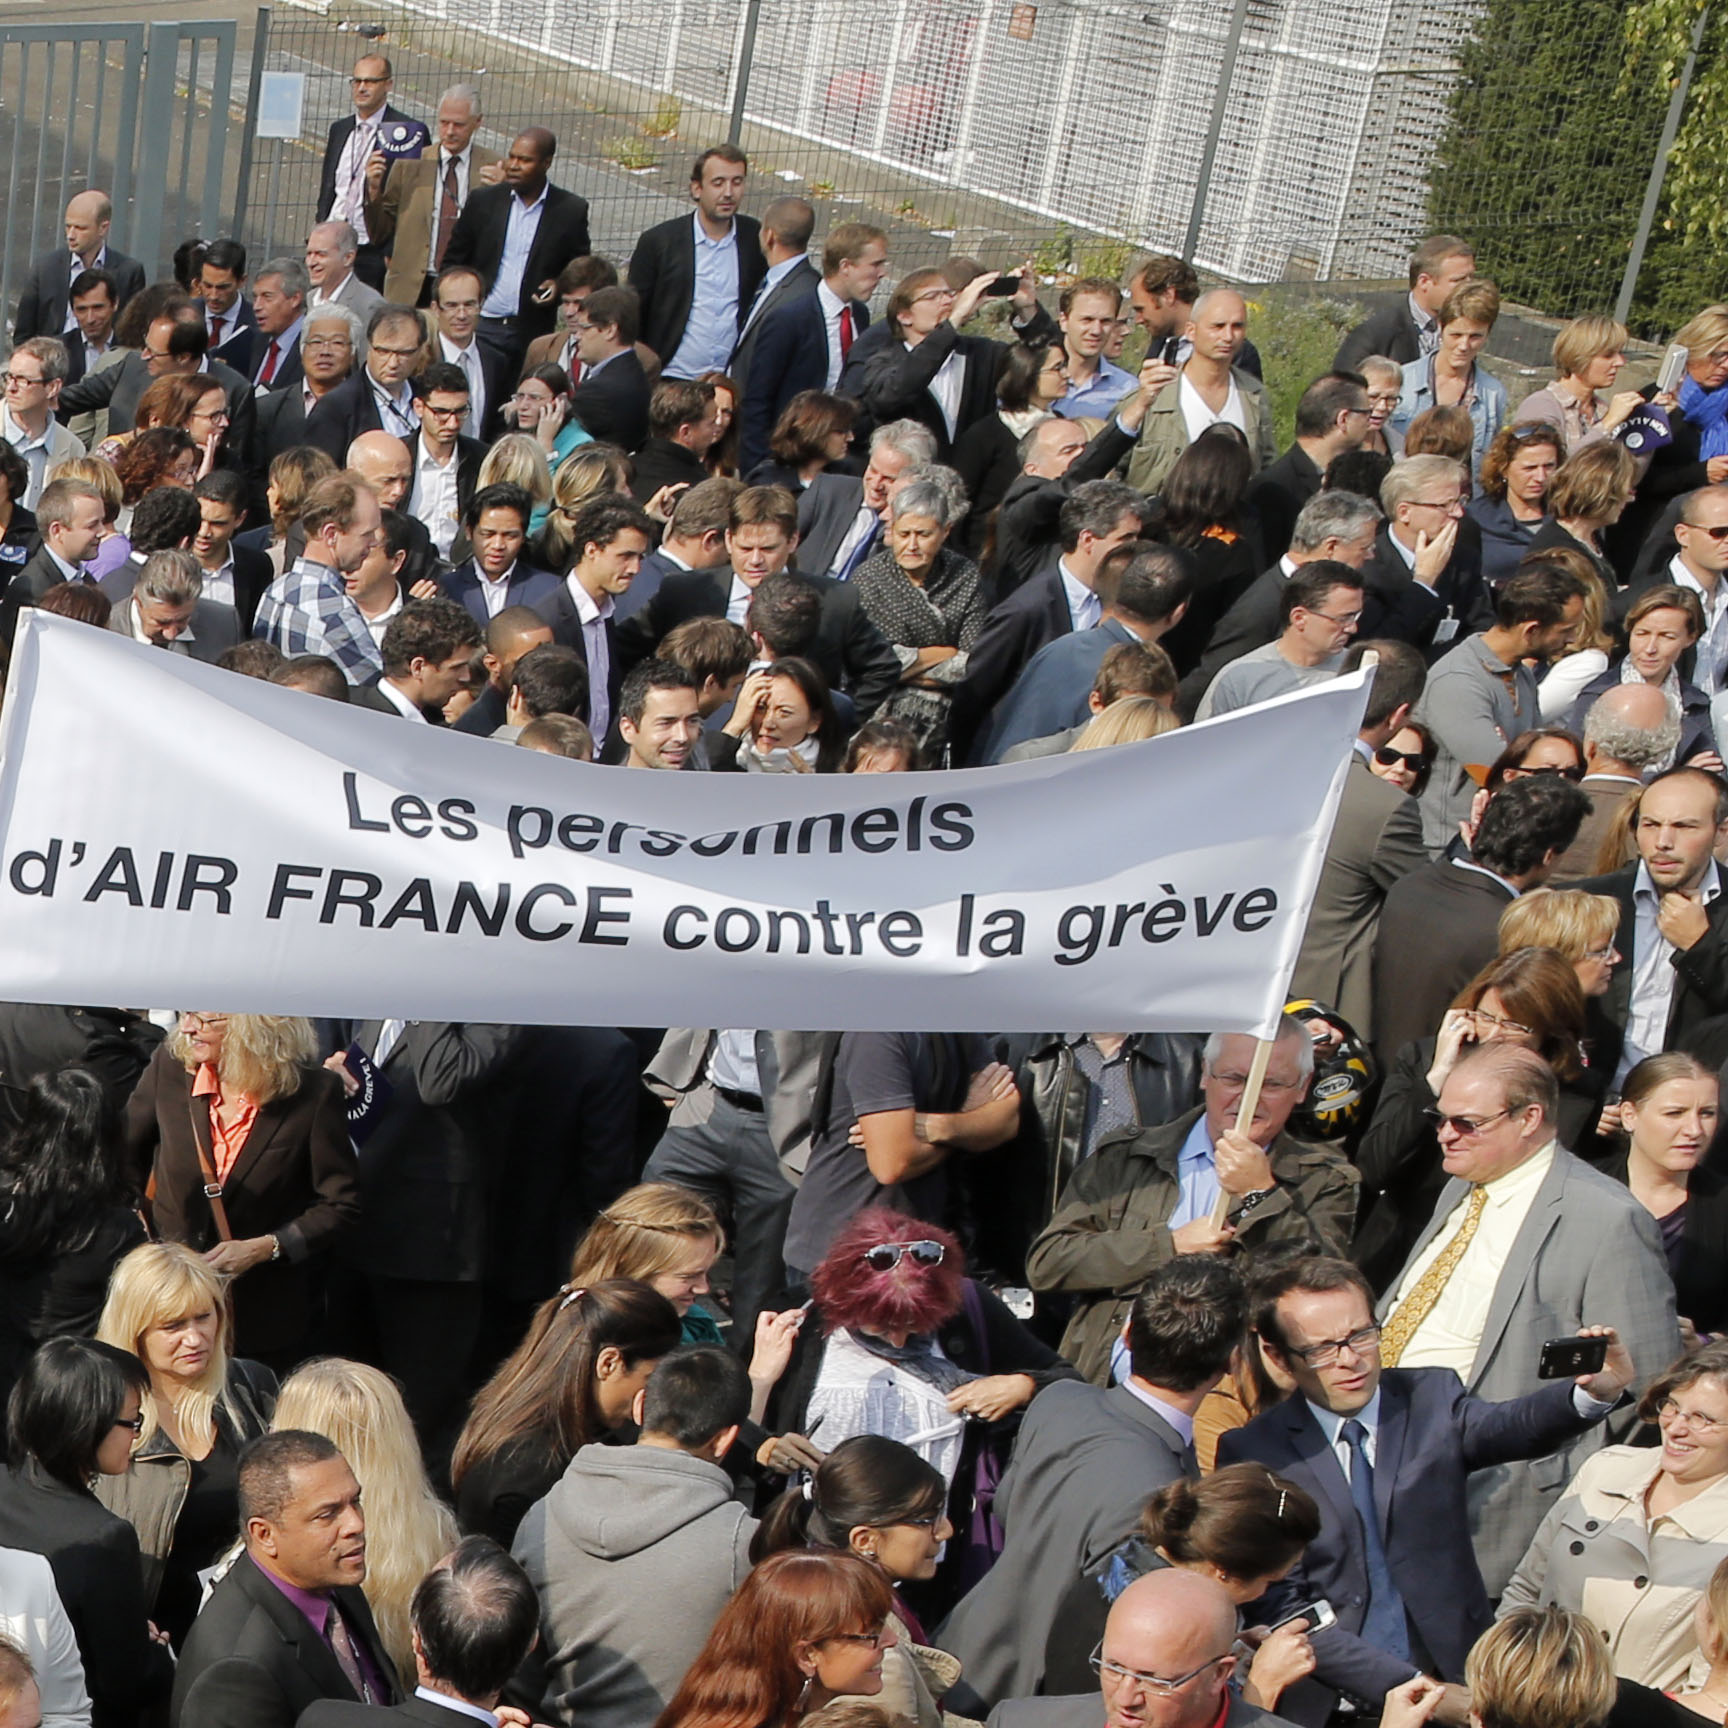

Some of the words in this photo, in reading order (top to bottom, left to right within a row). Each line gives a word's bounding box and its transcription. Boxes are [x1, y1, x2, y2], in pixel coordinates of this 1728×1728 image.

[342, 772, 478, 841] Les
[506, 796, 974, 859] personnels
[9, 838, 239, 915] d'AIR
[265, 863, 633, 946] FRANCE
[662, 900, 924, 958] contre
[956, 894, 1025, 957] la
[1054, 883, 1277, 966] grève
[362, 1064, 373, 1103] GREVE
